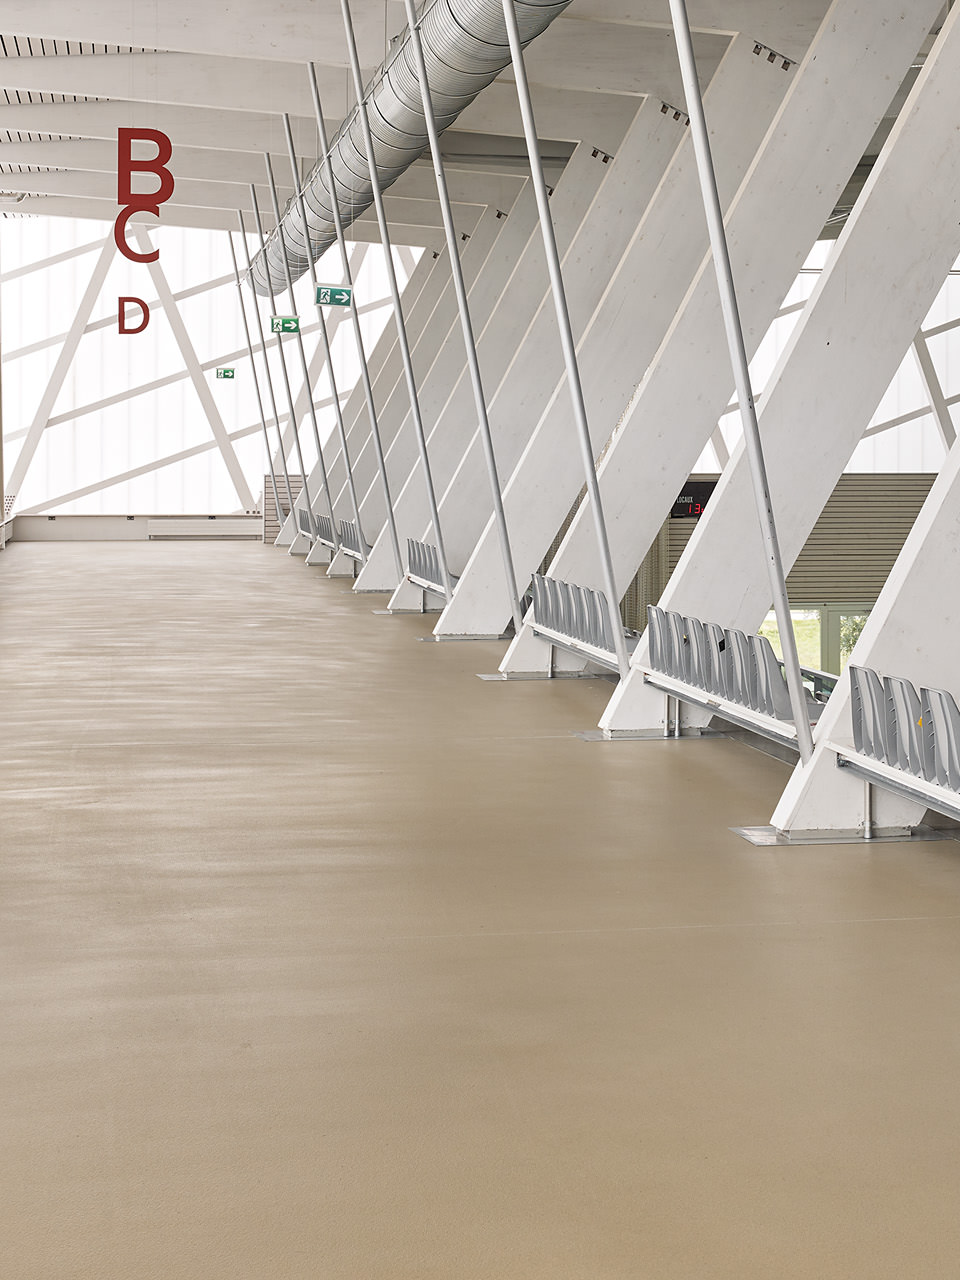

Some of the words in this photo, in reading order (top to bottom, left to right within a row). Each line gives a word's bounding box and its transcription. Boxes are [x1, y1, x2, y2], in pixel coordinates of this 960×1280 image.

[118, 128, 174, 205] B
[114, 204, 160, 264] C
[118, 297, 150, 335] D
